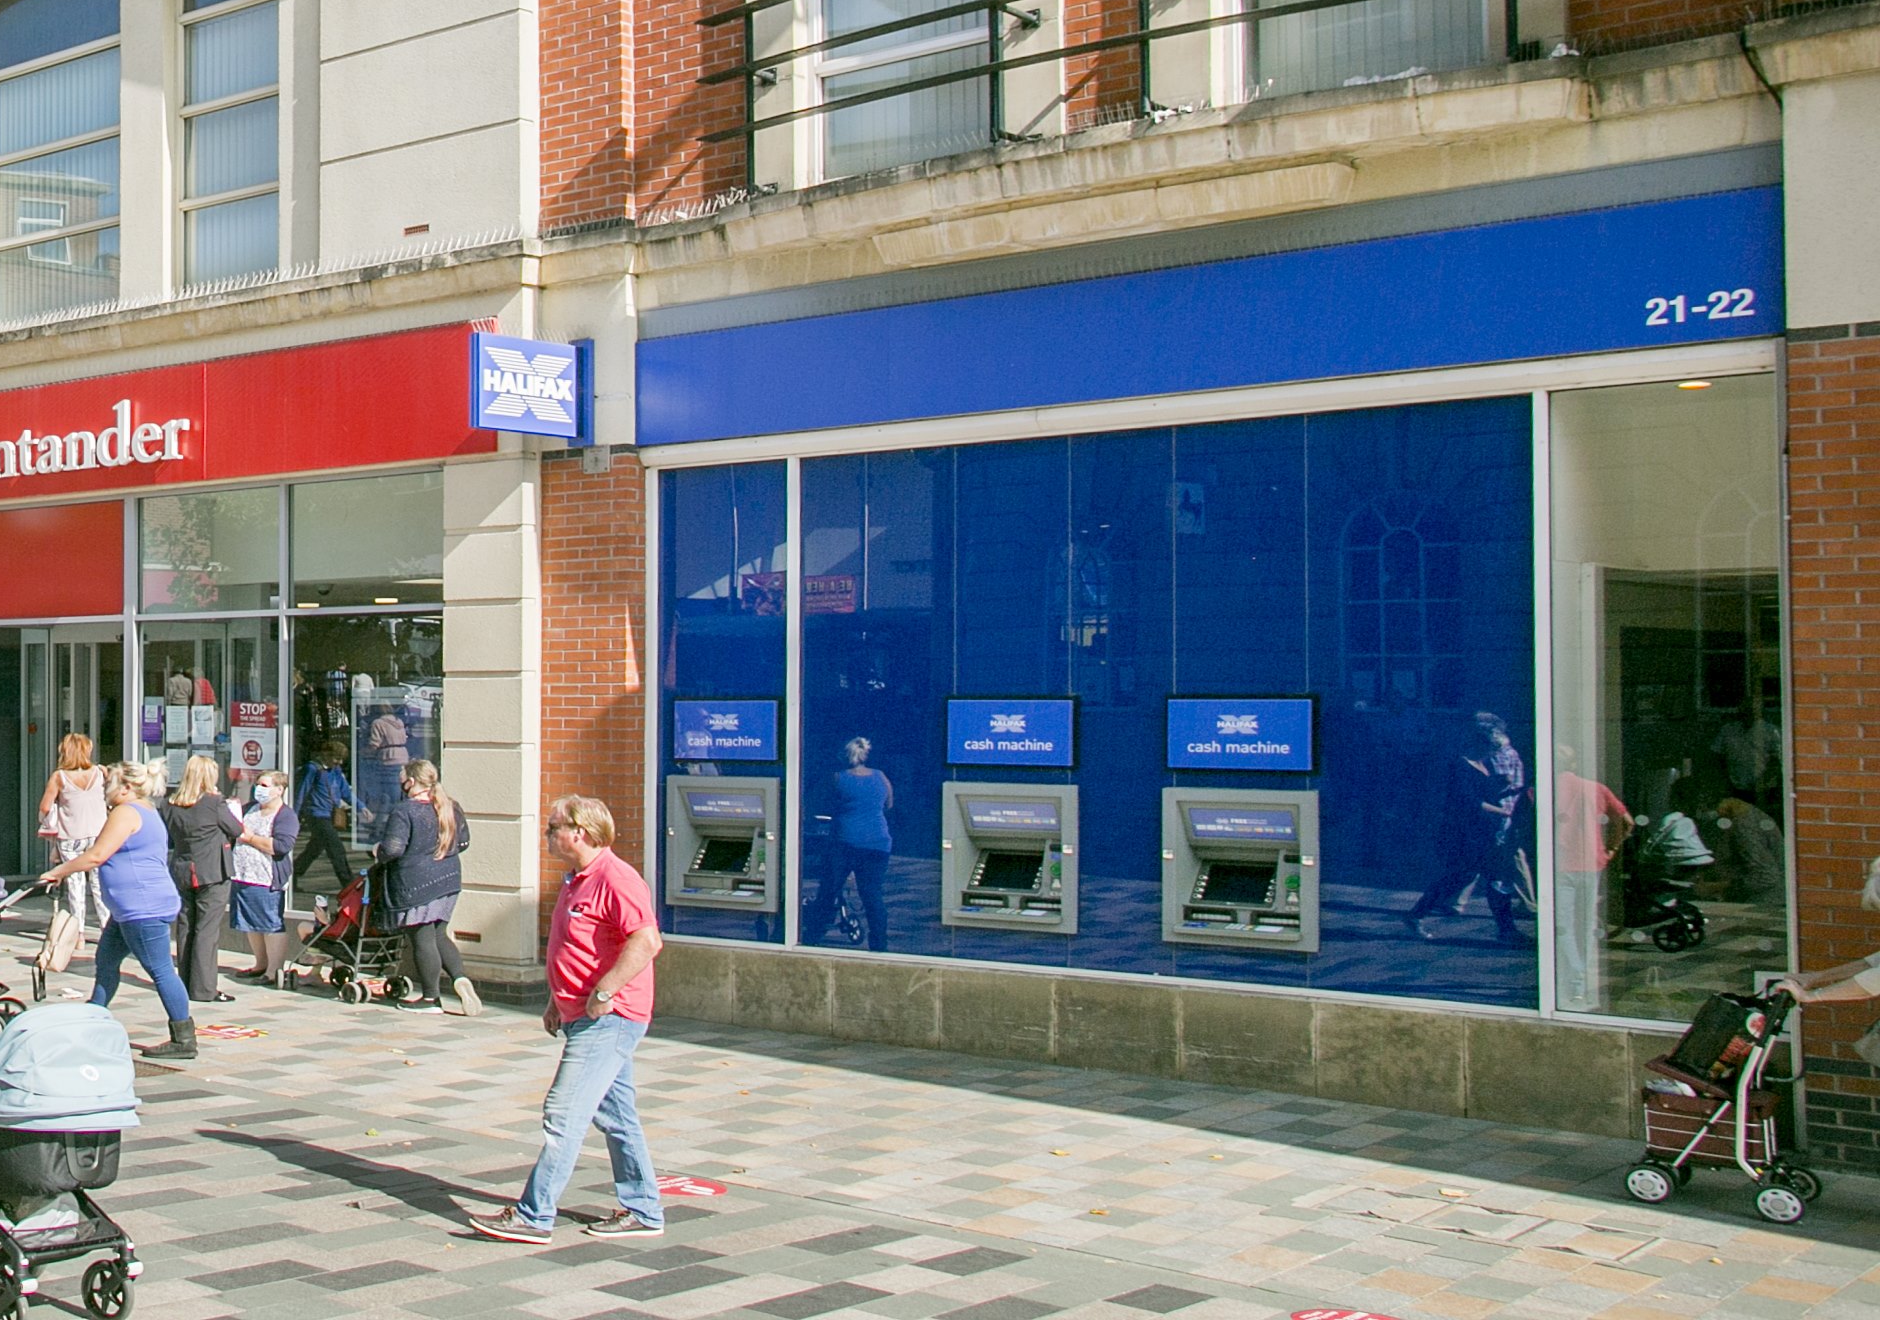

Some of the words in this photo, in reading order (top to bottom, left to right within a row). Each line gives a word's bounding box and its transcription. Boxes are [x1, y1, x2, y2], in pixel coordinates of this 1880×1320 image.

[1645, 288, 1756, 327] 21-22
[483, 368, 574, 402] HALIFAX
[240, 702, 267, 715] STOP
[1216, 720, 1259, 729] HALIFAX
[687, 735, 713, 747] cash
[716, 735, 762, 747] machine
[964, 738, 994, 750] cash
[997, 738, 1054, 751] machine
[1187, 740, 1221, 753] cash
[1225, 740, 1291, 754] machine
